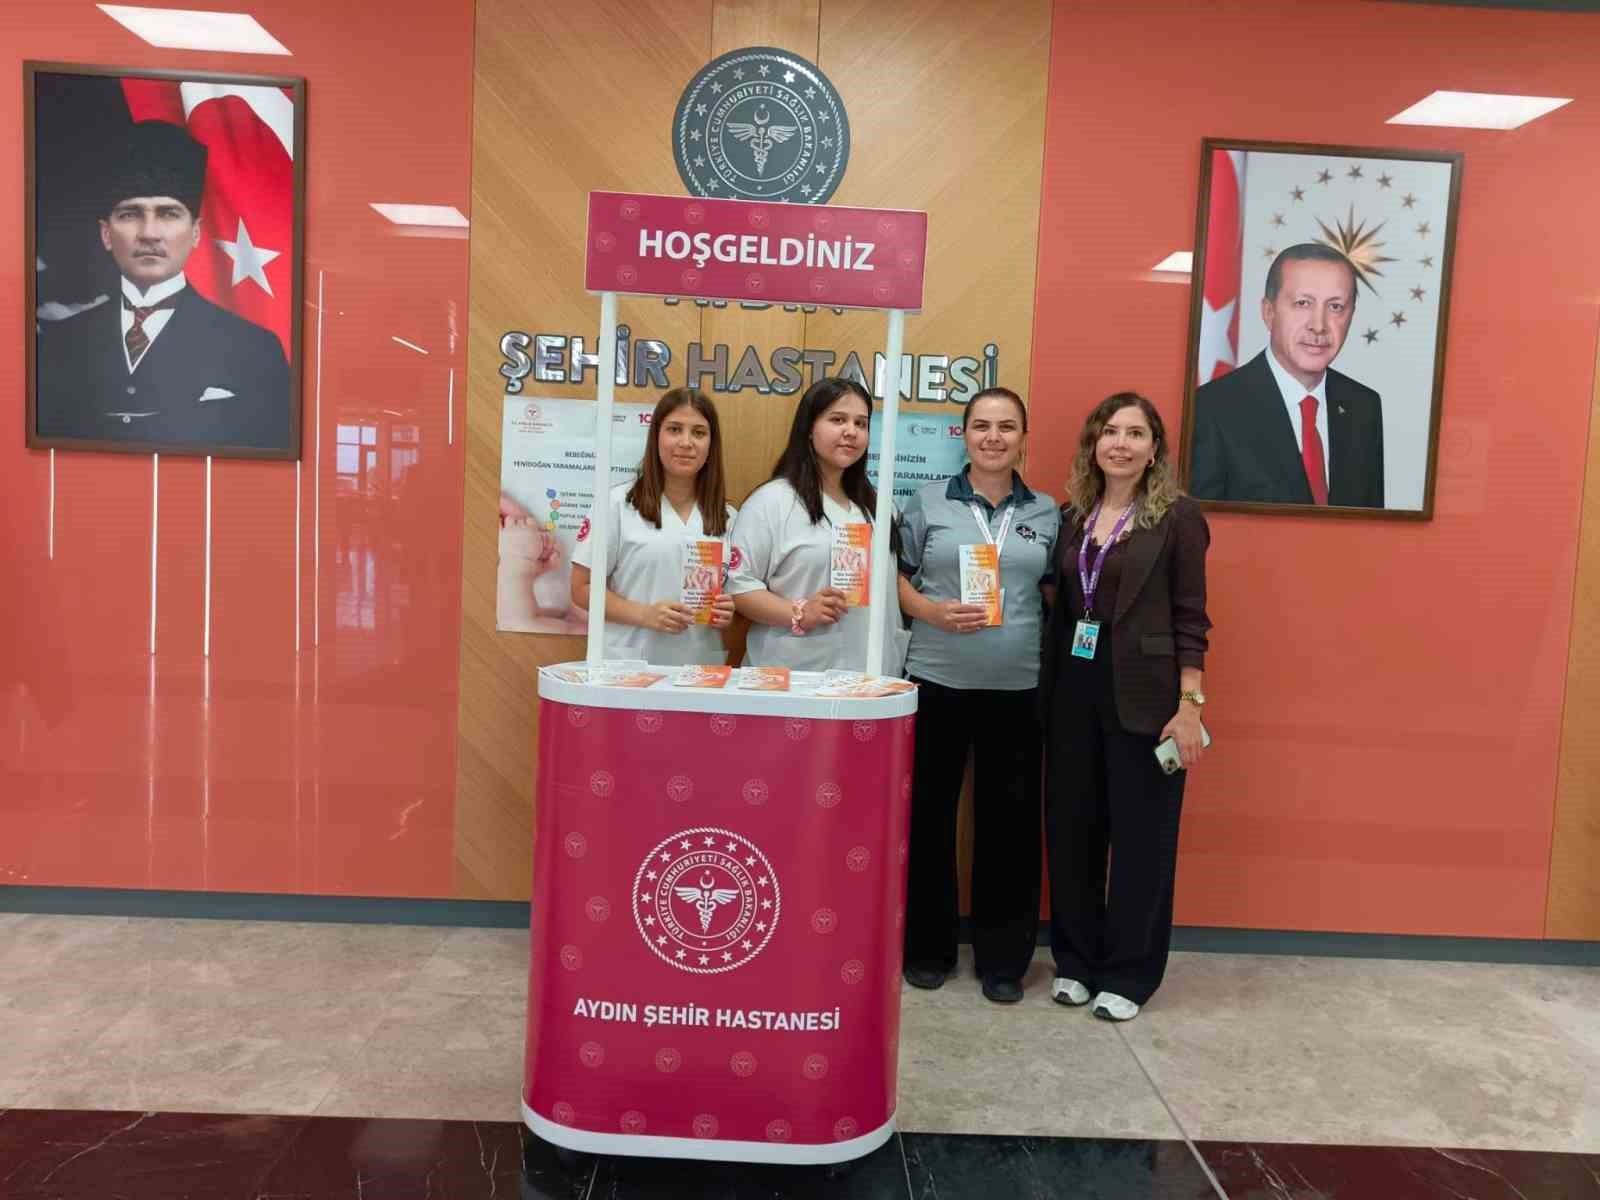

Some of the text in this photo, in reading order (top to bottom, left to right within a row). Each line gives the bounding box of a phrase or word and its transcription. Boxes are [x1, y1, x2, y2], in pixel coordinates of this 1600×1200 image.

[639, 228, 875, 270] HOŞGELDİNİZ
[500, 324, 999, 403] ŞEHİR HASTANESİ
[659, 854, 754, 942] TÜRKİYE CUMHURİYETİ SAĞLIK BAKANLIĞI
[573, 997, 841, 1031] AYDIN ŞEHİR HASTANESİ
